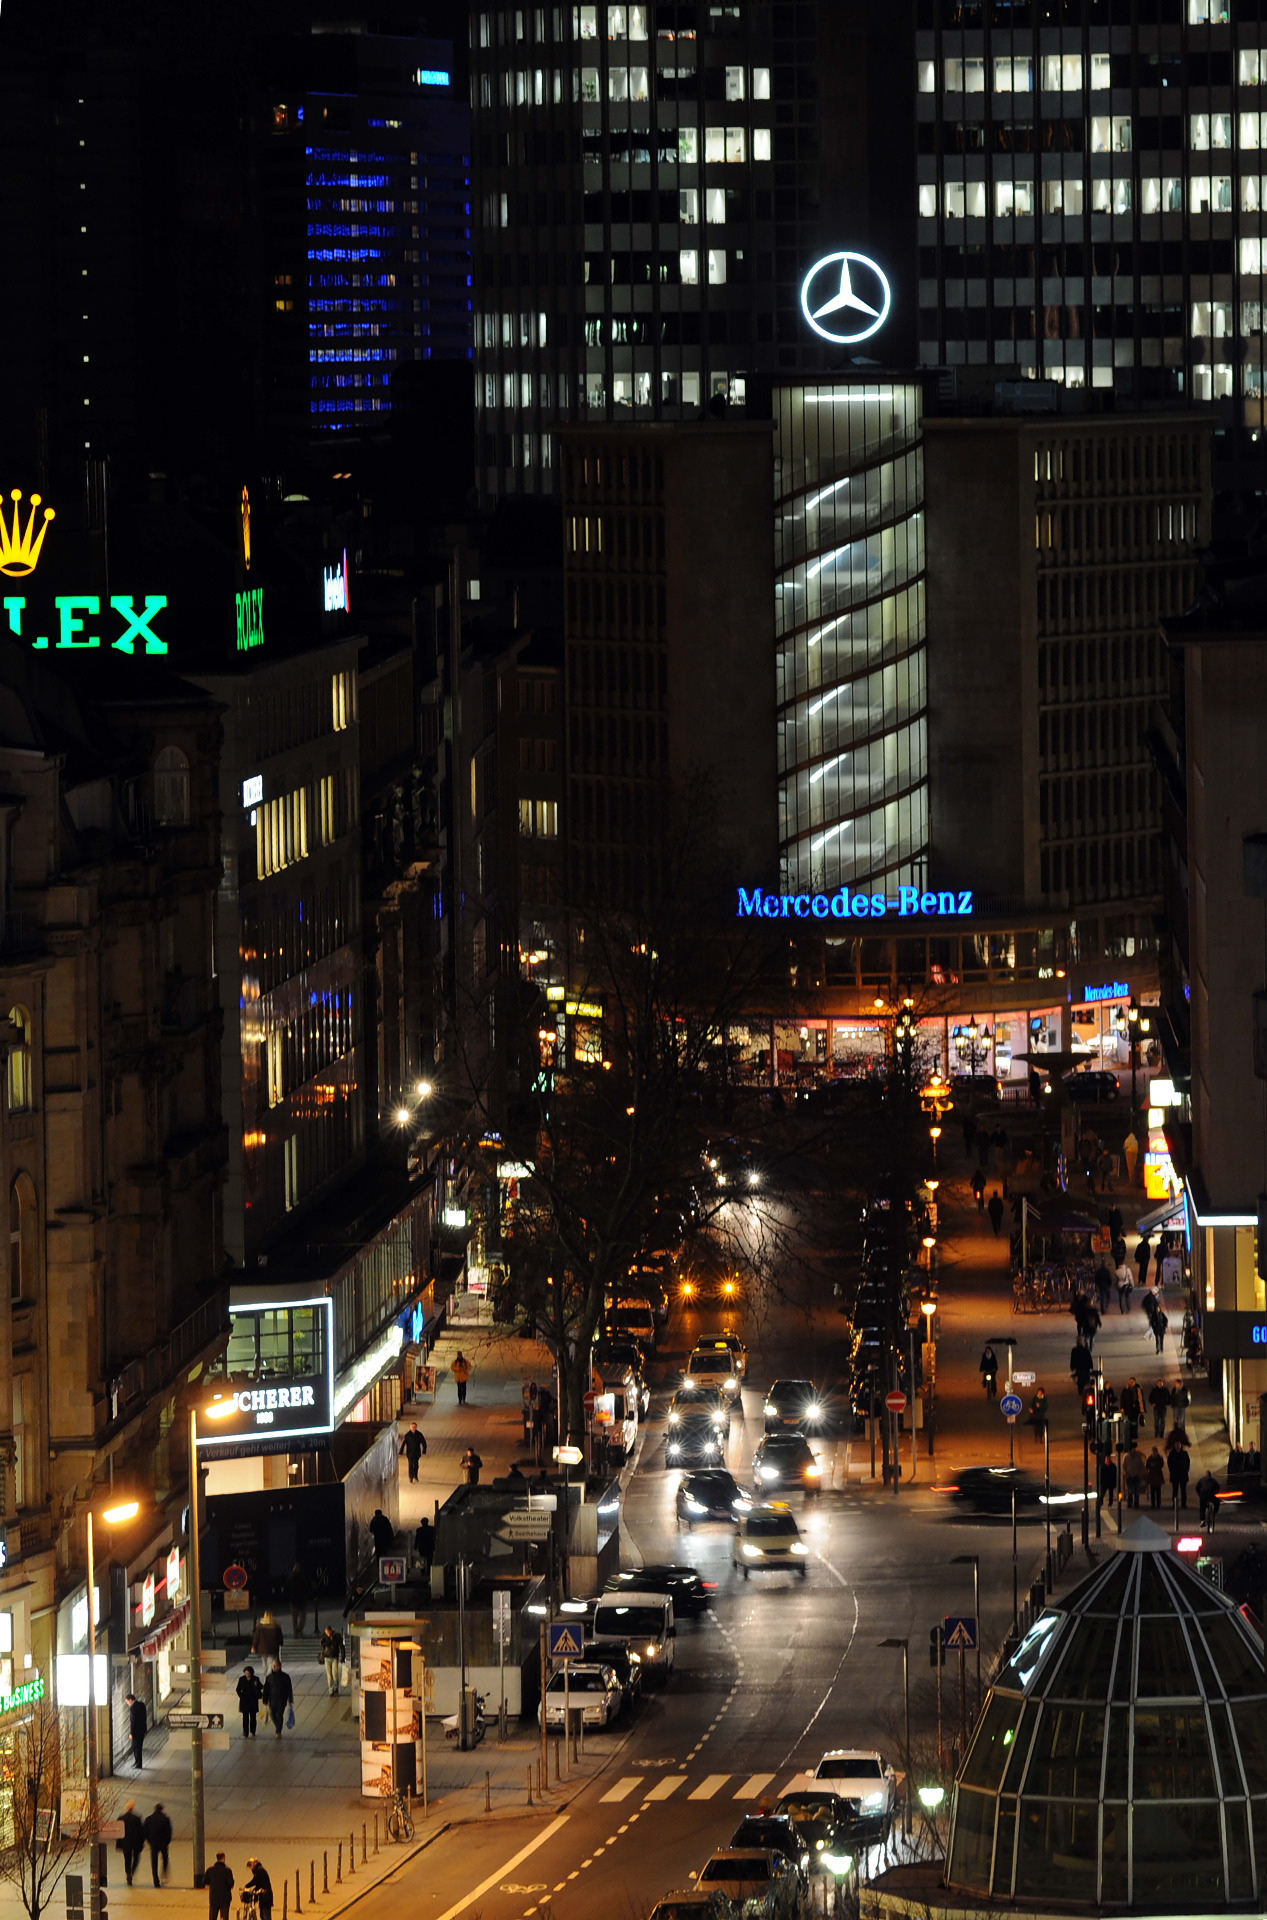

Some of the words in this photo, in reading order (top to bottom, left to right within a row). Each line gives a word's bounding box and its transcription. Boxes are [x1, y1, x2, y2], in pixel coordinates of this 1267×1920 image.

[236, 587, 264, 651] ROLEX
[736, 885, 973, 918] Mercedes-Benz
[1084, 981, 1129, 1002] Mercedes-Benz
[213, 1385, 315, 1412] CHERER
